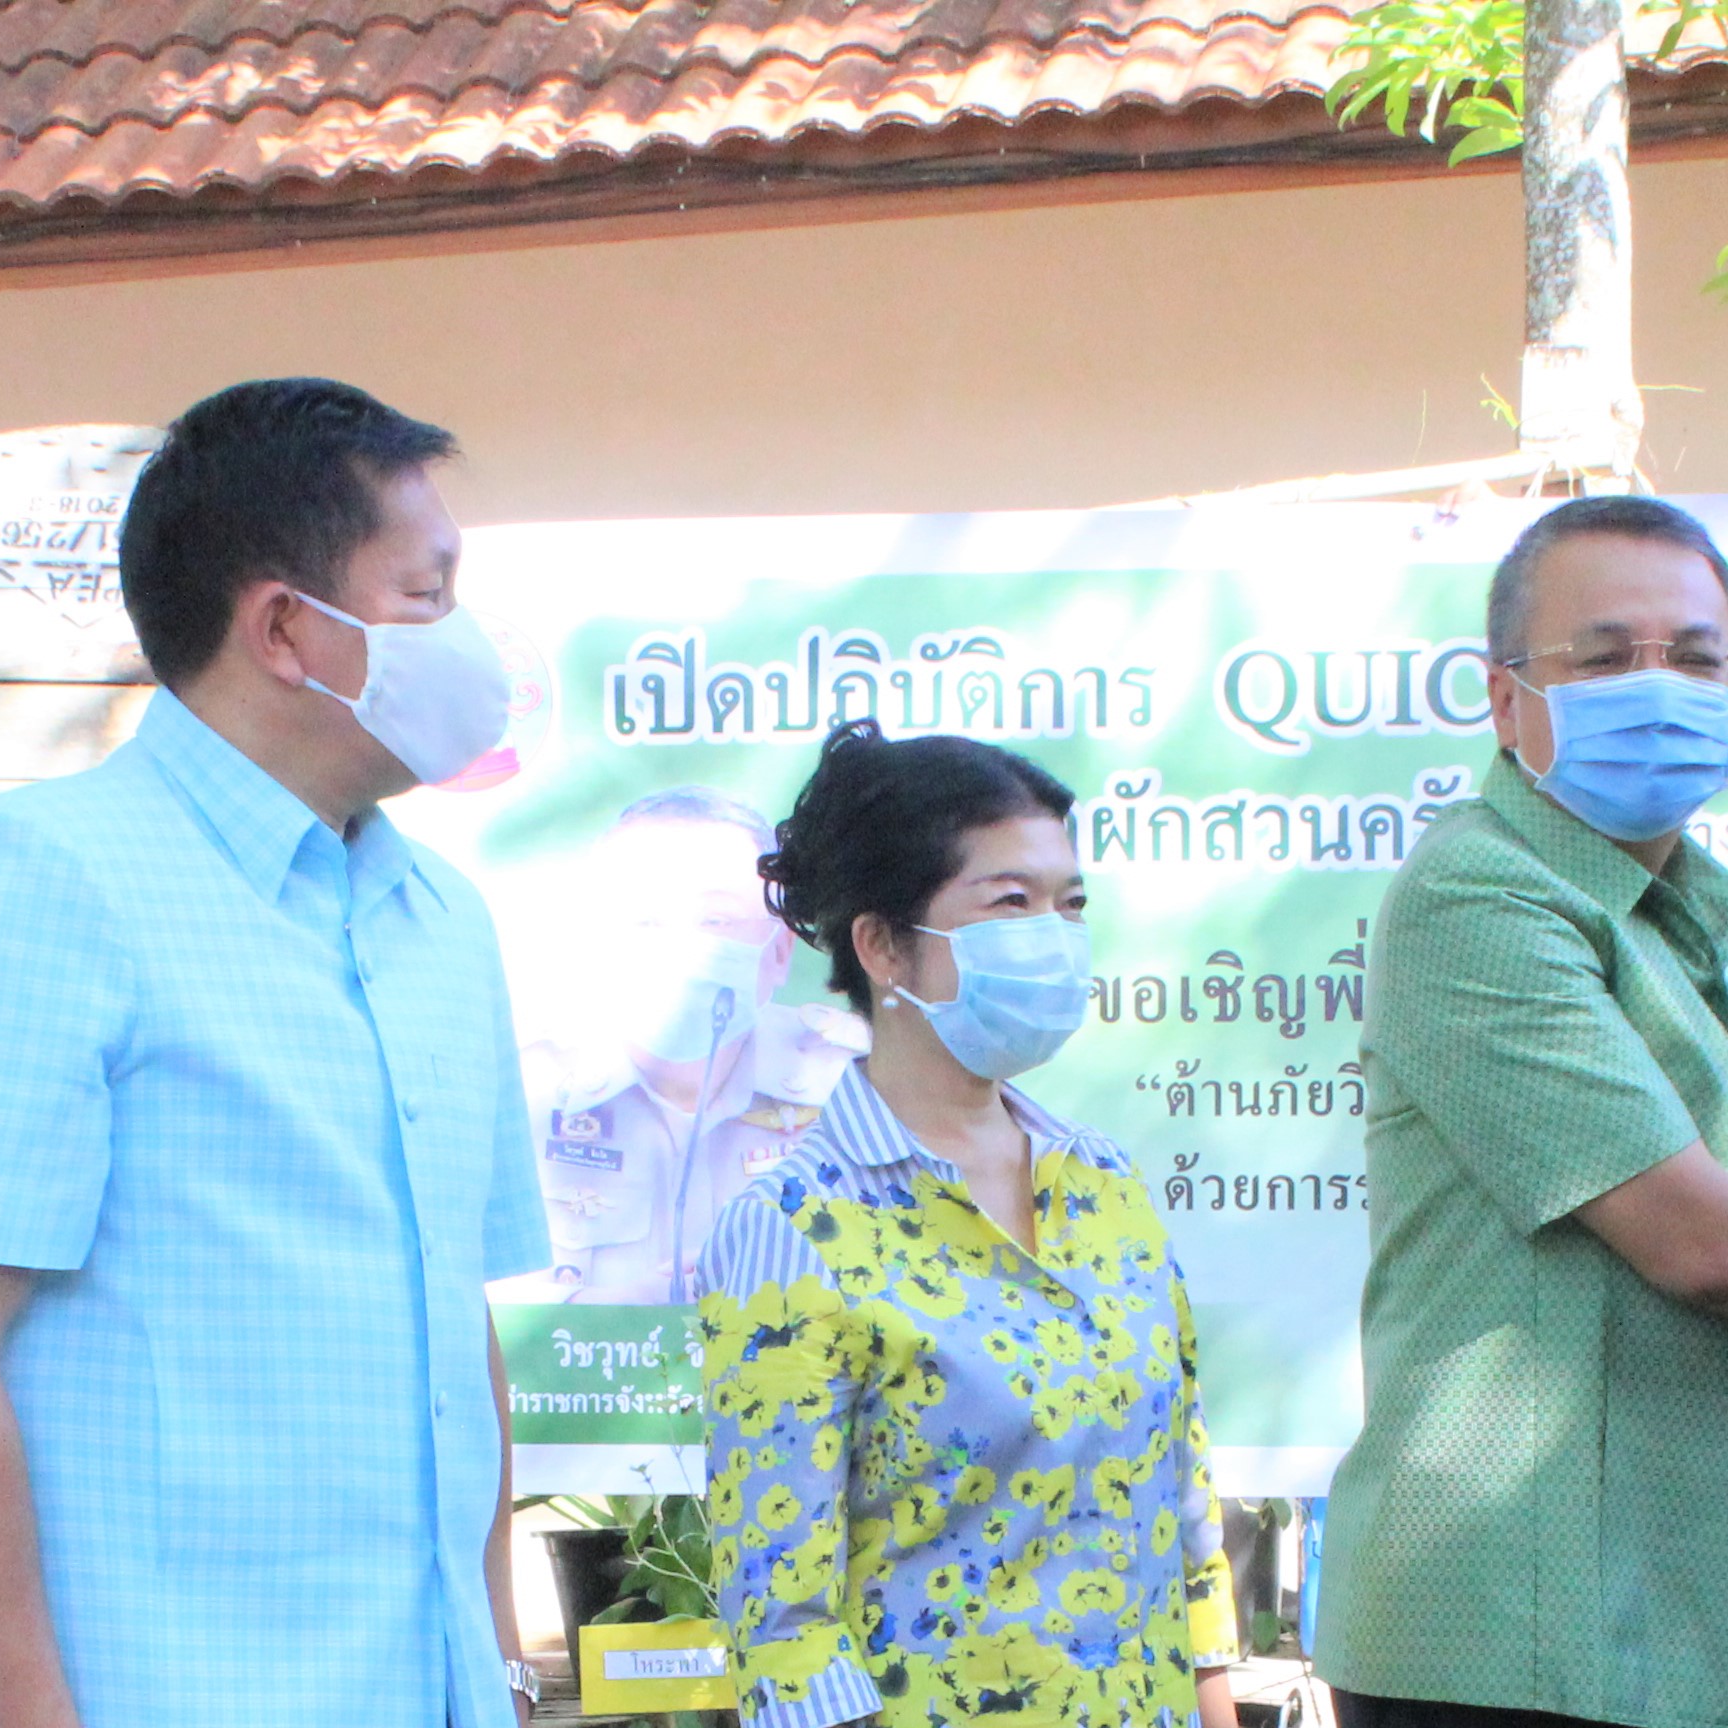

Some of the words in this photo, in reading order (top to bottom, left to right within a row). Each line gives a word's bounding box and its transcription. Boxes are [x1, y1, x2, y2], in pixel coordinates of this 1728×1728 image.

[613, 635, 1158, 737] เปิดปฏิบัติการ
[1223, 646, 1494, 746] QUIC
[1087, 917, 1368, 1039] ขอเชิญพี่
[1135, 1057, 1366, 1117] “ต้านภัยวิ
